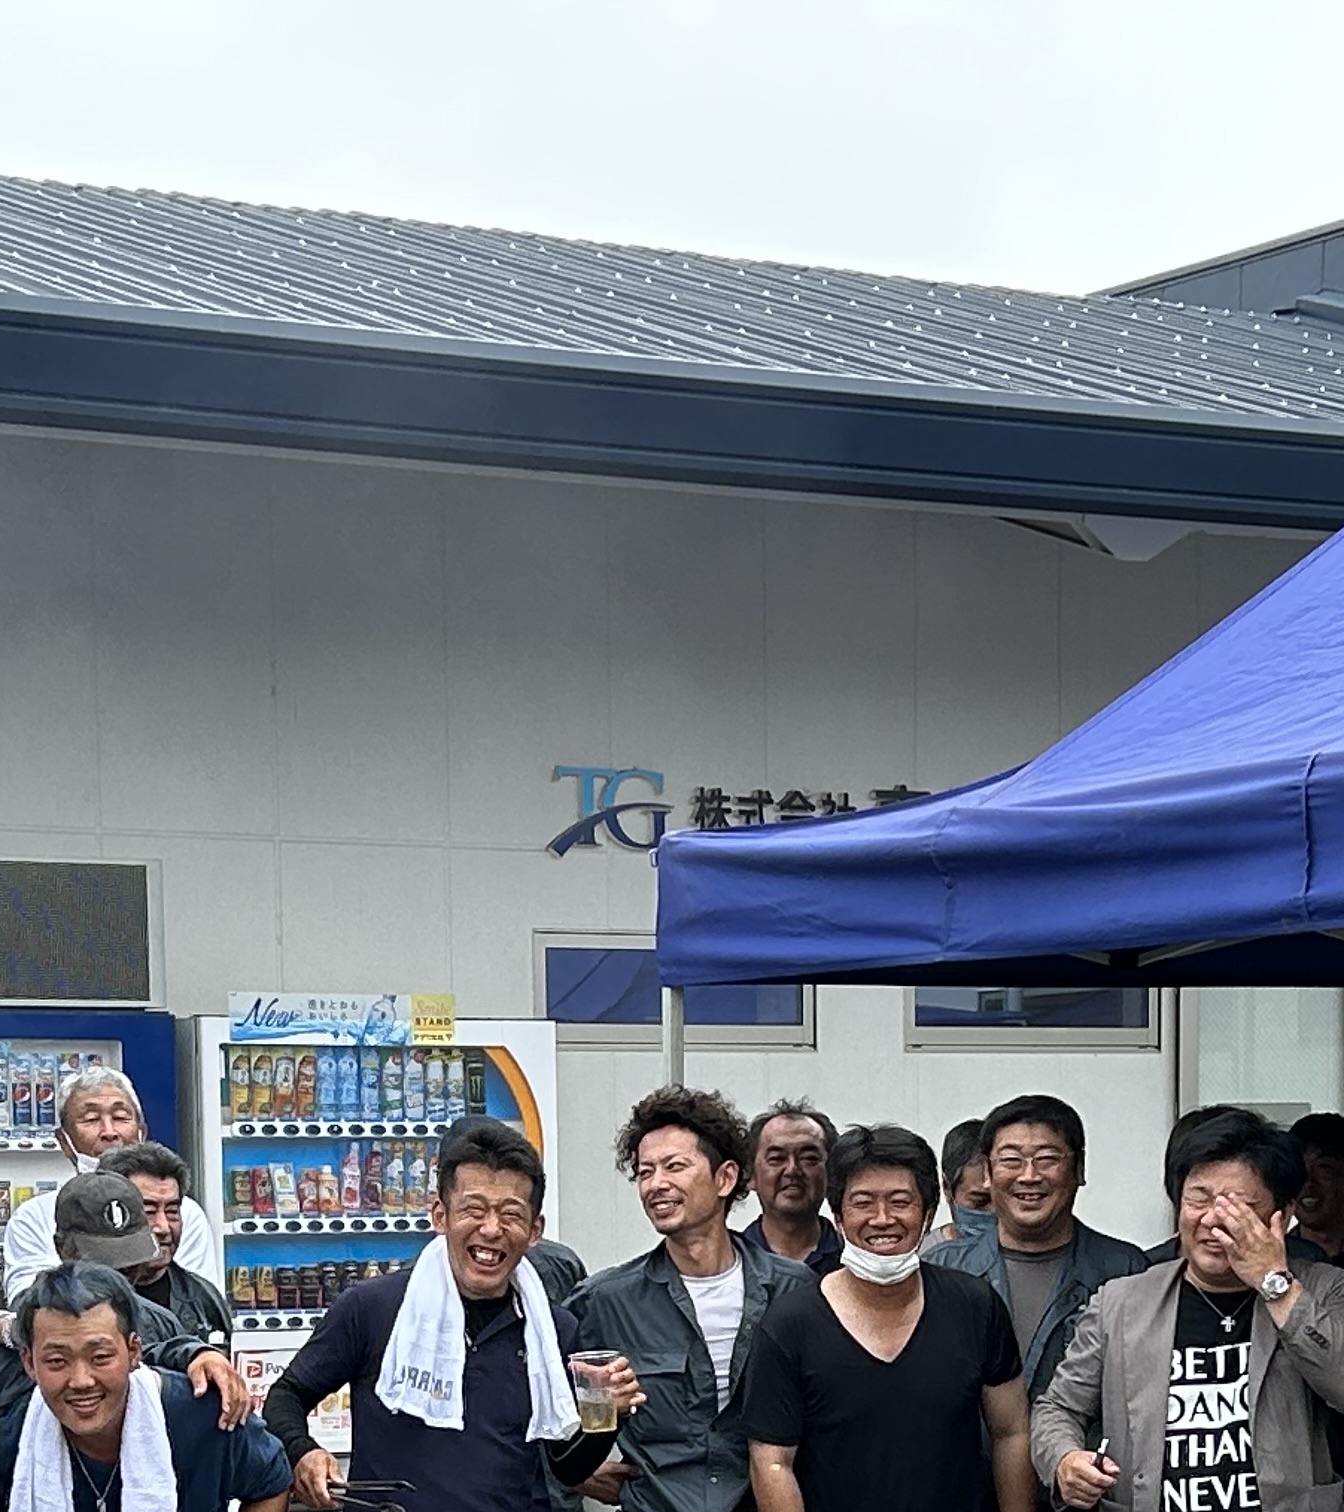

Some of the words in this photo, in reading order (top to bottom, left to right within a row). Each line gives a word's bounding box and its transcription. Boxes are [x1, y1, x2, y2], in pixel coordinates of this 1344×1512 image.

[549, 766, 674, 857] TG
[689, 784, 932, 830] 株式会社
